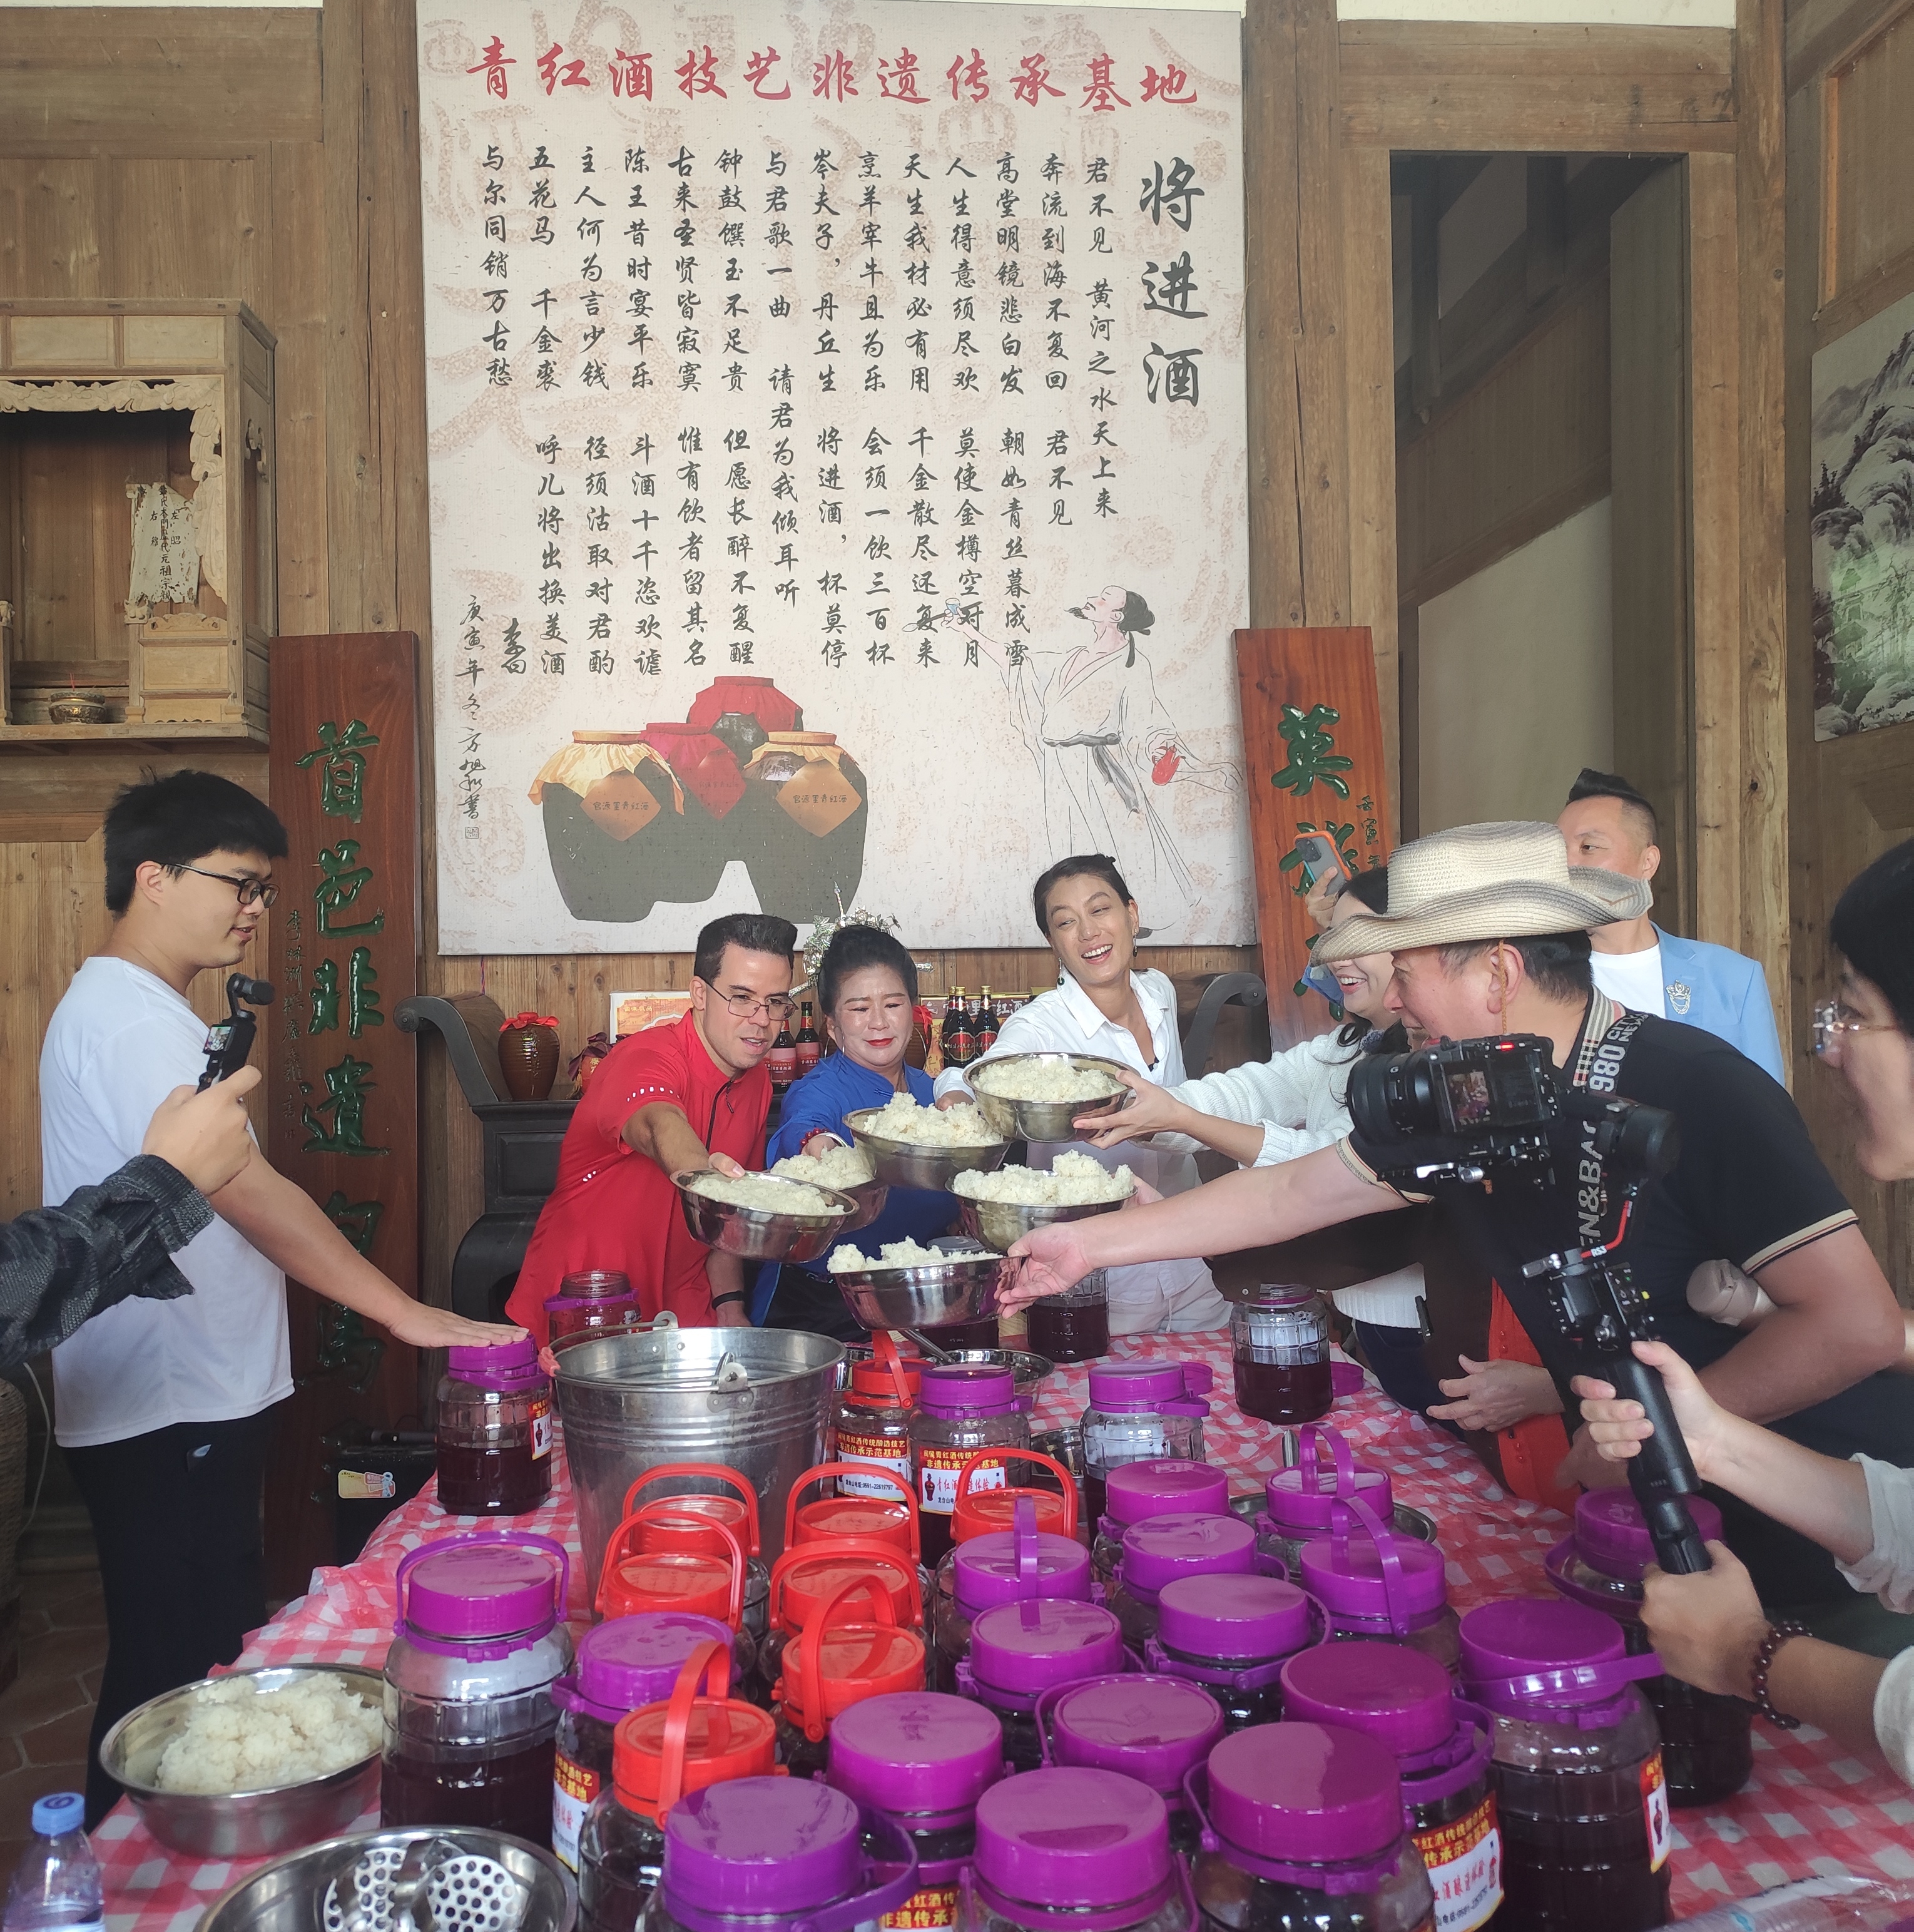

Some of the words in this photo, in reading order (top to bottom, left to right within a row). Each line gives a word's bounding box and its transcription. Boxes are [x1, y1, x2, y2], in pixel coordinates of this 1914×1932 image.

[466, 35, 1198, 112] 青红酒技艺非遗传承基地
[479, 144, 513, 386] 与尔同销万古愁
[528, 145, 557, 246] 五花马
[573, 146, 610, 391] 主人何为言少钱
[623, 145, 654, 389] 陈王昔时宴平乐
[667, 145, 702, 392] 古来圣贤皆寂寞
[713, 148, 750, 392] 钟鼓馔玉不足贵
[763, 150, 793, 318] 与君歌一曲
[857, 150, 886, 392] 烹羊宰牛且为乐
[903, 153, 932, 394] 天生我材必有用
[945, 157, 980, 392] 人生得意须尽欢
[994, 151, 1024, 395] 高堂明镜悲白发
[1040, 153, 1071, 391] 奔流到海不复回
[1084, 157, 1114, 253] 君不见
[1139, 156, 1209, 407] 将进酒
[531, 287, 562, 392] 千金裘
[812, 292, 841, 392] 丹丘生
[1085, 277, 1119, 519] 黄河之水天上来
[535, 434, 568, 676] 呼儿将出换美酒
[583, 436, 615, 676] 径须沽取对君酌
[629, 432, 663, 676] 斗酒十千恣欢谑
[676, 426, 708, 667] 惟有饮者留其名
[723, 428, 756, 665] 但愿长醉不复醒
[767, 363, 800, 608] 请君为我倾耳听
[861, 426, 895, 667] 会须一饮三百杯
[999, 427, 1033, 669] 朝如青丝暮成雪
[1044, 429, 1074, 526] 君不见
[816, 570, 848, 669] 杯莫停
[1589, 1043, 1626, 1093] 980
[905, 1891, 961, 1909] 红酒传
